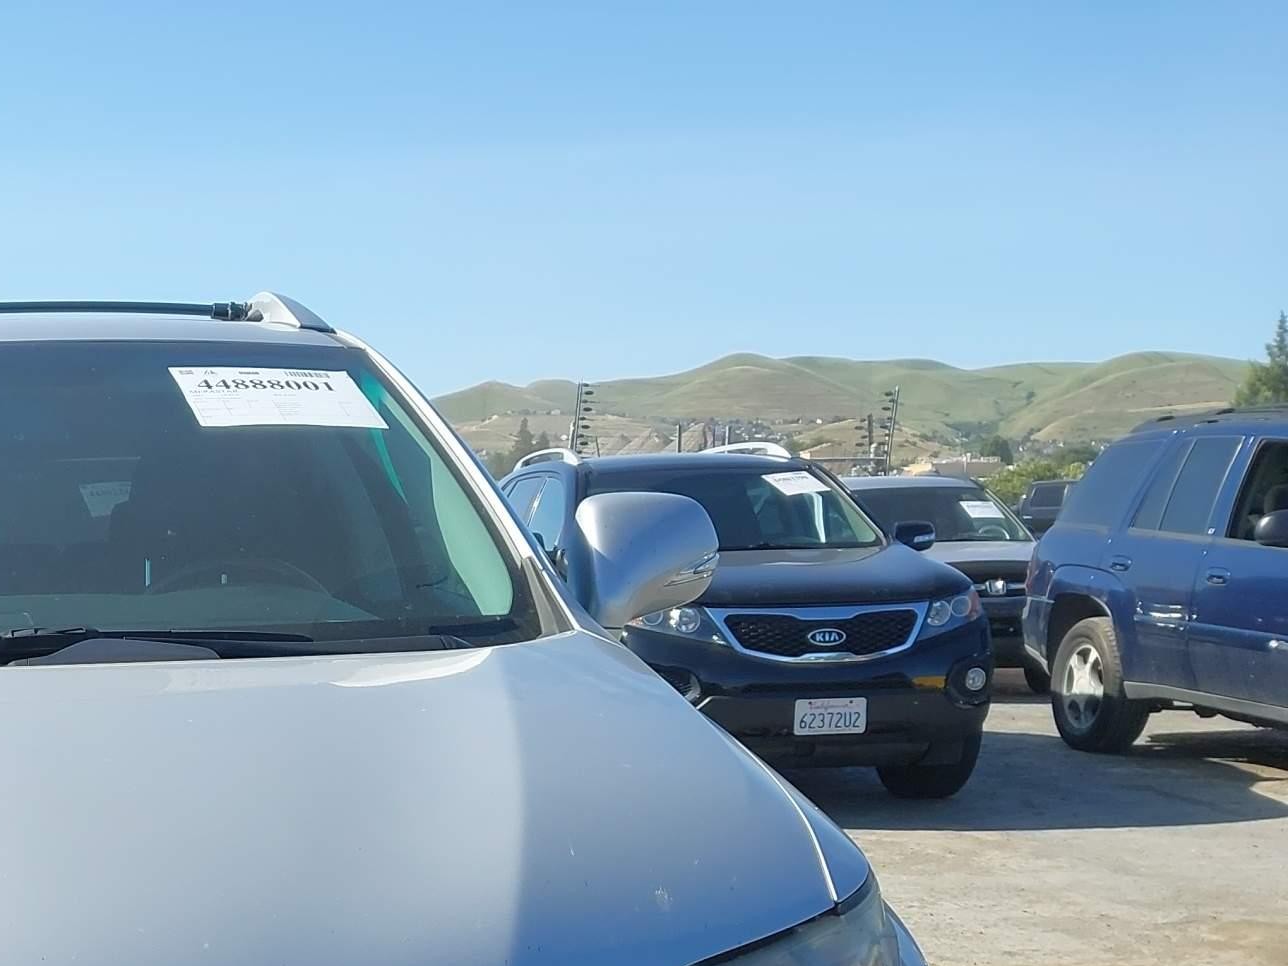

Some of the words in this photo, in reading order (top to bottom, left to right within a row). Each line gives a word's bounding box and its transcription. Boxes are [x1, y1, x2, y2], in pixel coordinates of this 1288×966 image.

[197, 378, 336, 392] 44888001
[814, 631, 840, 642] KIA
[799, 711, 861, 729] 62372U2
